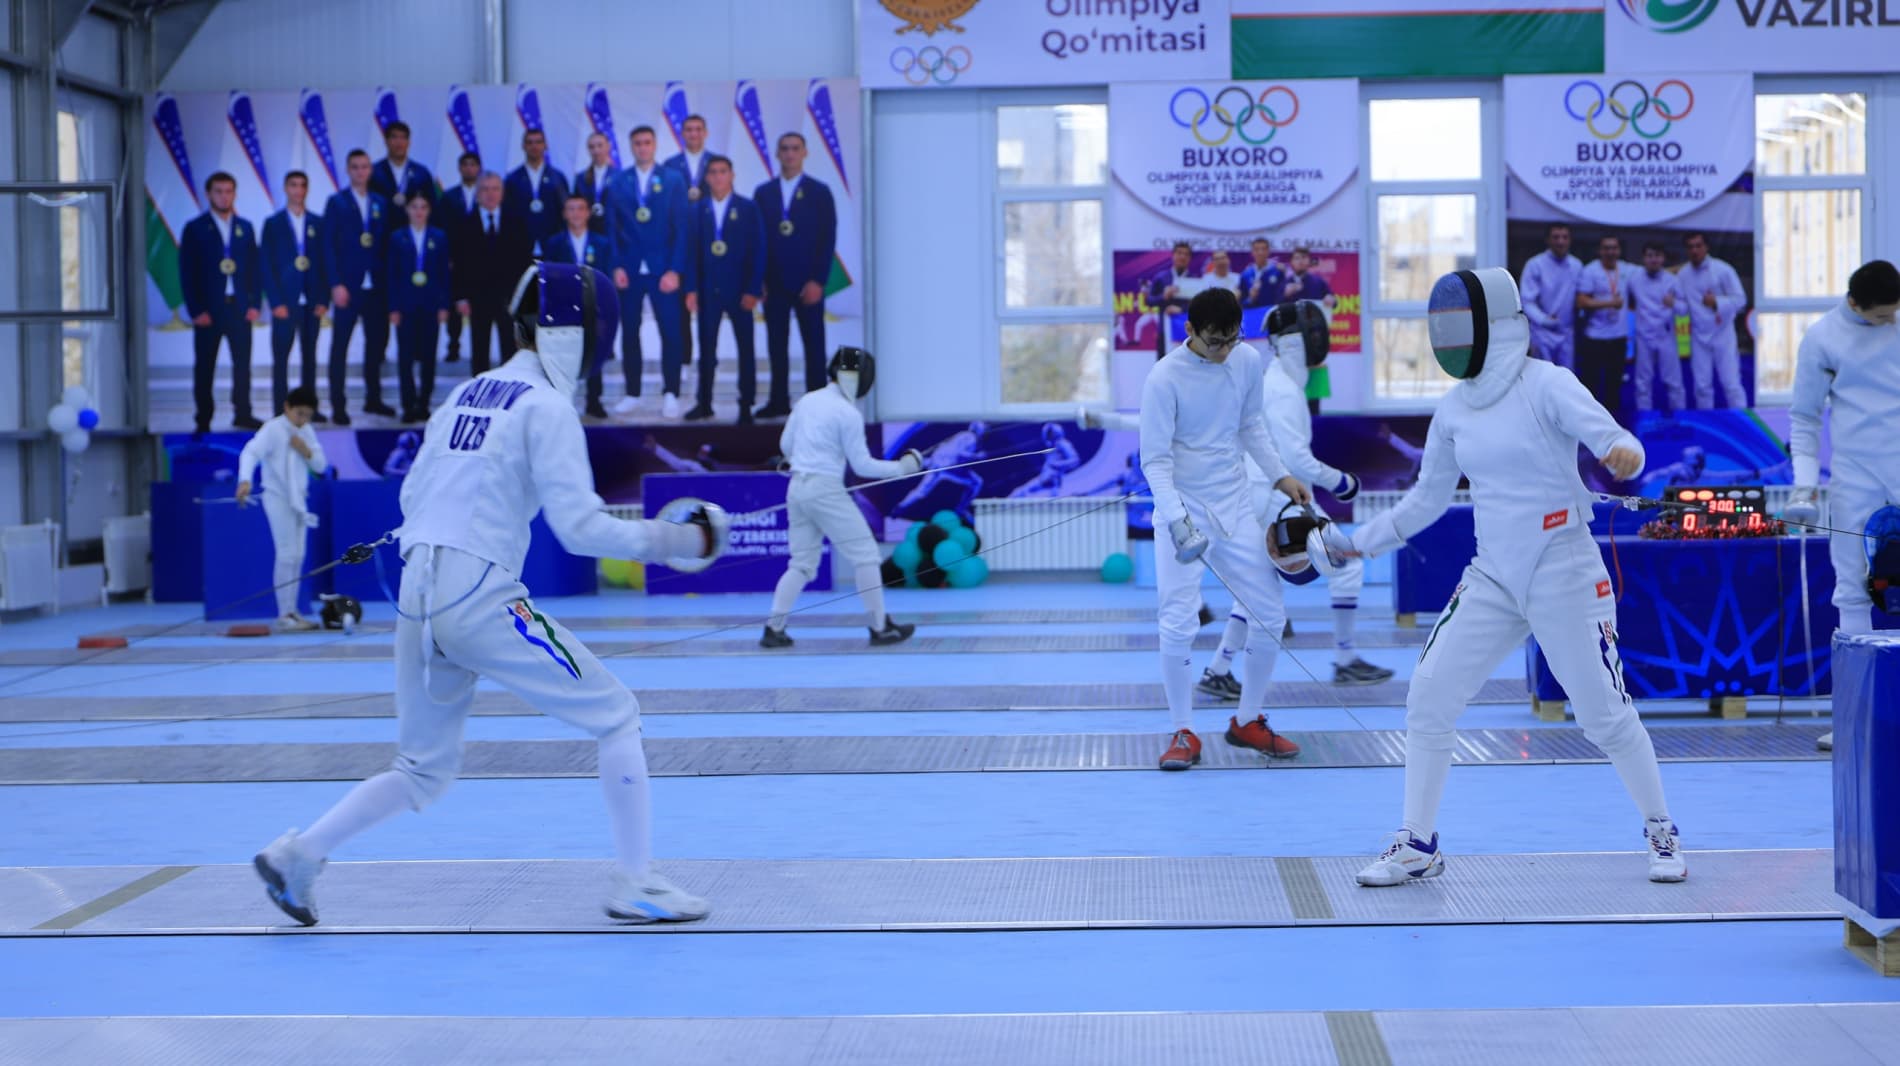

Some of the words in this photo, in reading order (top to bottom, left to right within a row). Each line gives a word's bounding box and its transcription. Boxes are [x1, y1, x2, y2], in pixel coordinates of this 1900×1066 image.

[1046, 0, 1199, 20] Olimpiya
[1183, 147, 1287, 167] BUXORO
[1577, 142, 1682, 162] BUXORO
[1147, 171, 1210, 182] OLIMPIYA
[1214, 171, 1232, 180] VA
[1236, 169, 1323, 180] PARALIMPIYA
[1541, 166, 1604, 177] OLIMPIYA
[1608, 166, 1626, 176] VA
[1630, 164, 1718, 175] PARALIMPIYA
[1174, 183, 1217, 194] SPORT
[1569, 178, 1612, 188] SPORT
[1161, 196, 1247, 207] TAYYORLASH
[1251, 194, 1311, 205] MARKAZI
[1555, 190, 1641, 201] TAYYORLASH
[1645, 190, 1704, 200] MARKAZI
[449, 414, 491, 451] UZB
[1683, 514, 1696, 531] 0
